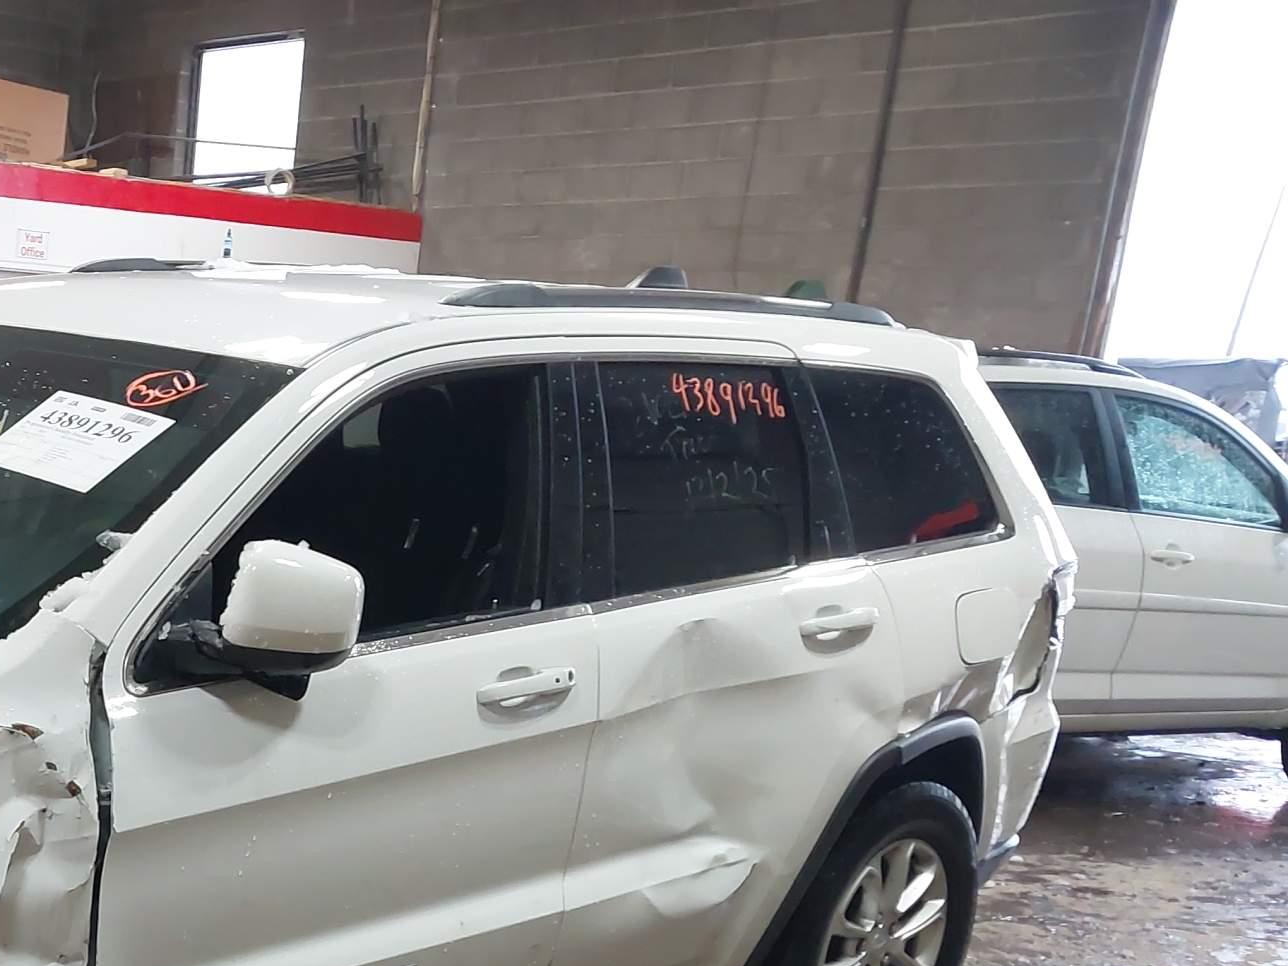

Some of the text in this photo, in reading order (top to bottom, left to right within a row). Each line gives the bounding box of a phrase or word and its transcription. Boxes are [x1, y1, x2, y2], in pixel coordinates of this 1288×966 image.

[24, 232, 43, 244] Yard
[20, 246, 45, 258] Office
[672, 373, 785, 424] 43891296
[39, 409, 140, 444] 43891296
